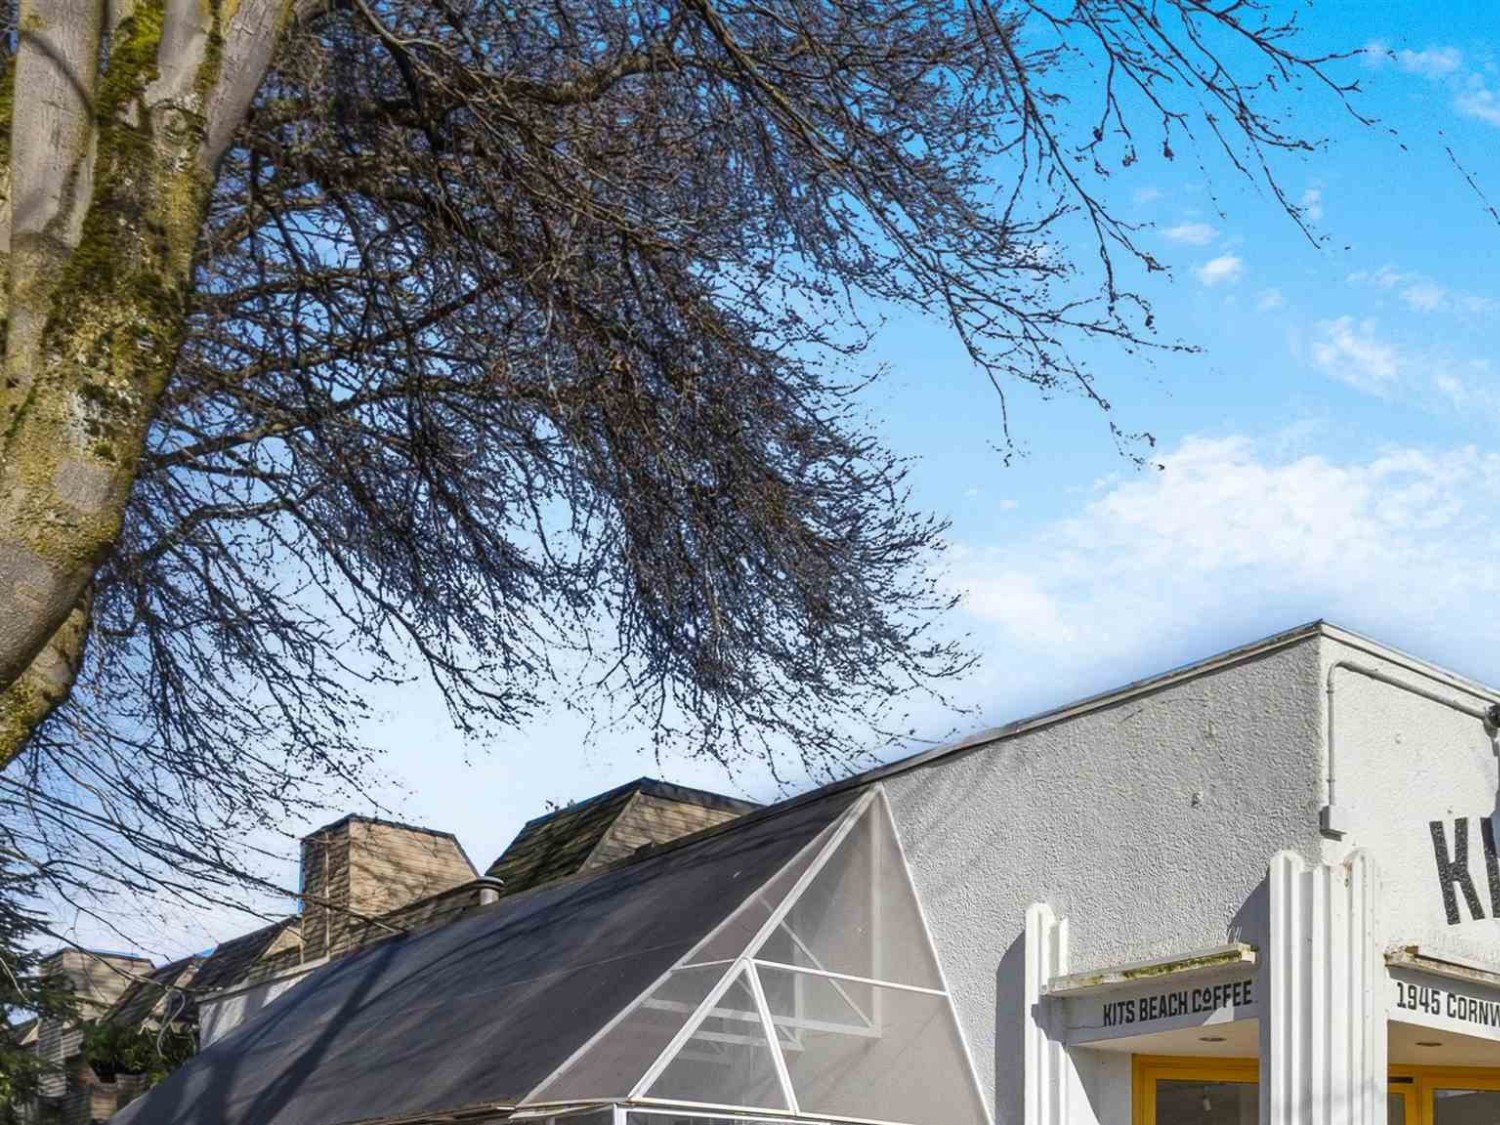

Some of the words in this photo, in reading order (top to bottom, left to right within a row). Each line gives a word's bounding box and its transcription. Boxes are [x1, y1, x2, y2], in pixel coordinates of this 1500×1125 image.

[1103, 999, 1135, 1027] KITS
[1139, 990, 1188, 1022] BEACH
[1192, 979, 1253, 1013] COFFEE
[1396, 981, 1440, 1015] 1945
